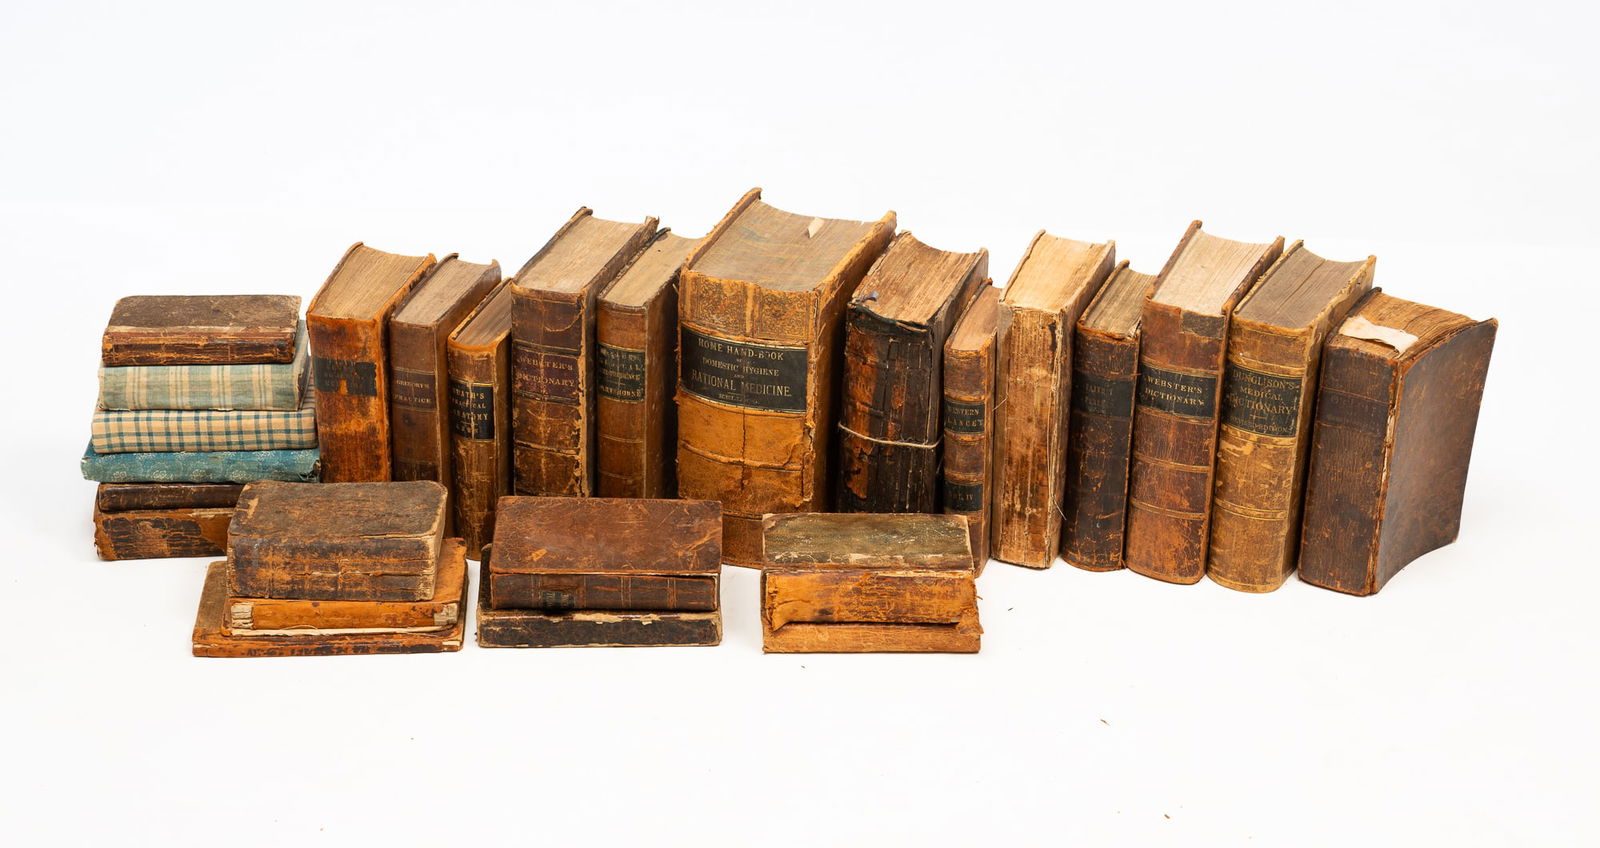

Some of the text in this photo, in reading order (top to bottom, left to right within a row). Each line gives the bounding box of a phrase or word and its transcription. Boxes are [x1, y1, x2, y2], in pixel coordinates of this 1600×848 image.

[698, 338, 723, 353] HOME
[702, 356, 780, 378] DOMESTIC HYGIENE
[691, 369, 792, 397] RATIONAL MEDICINE
[1146, 375, 1204, 394] WEBSTER'S
[1144, 386, 1205, 406] DICTIONARY
[1240, 386, 1285, 402] MEDICAL
[947, 417, 984, 427] LANCET
